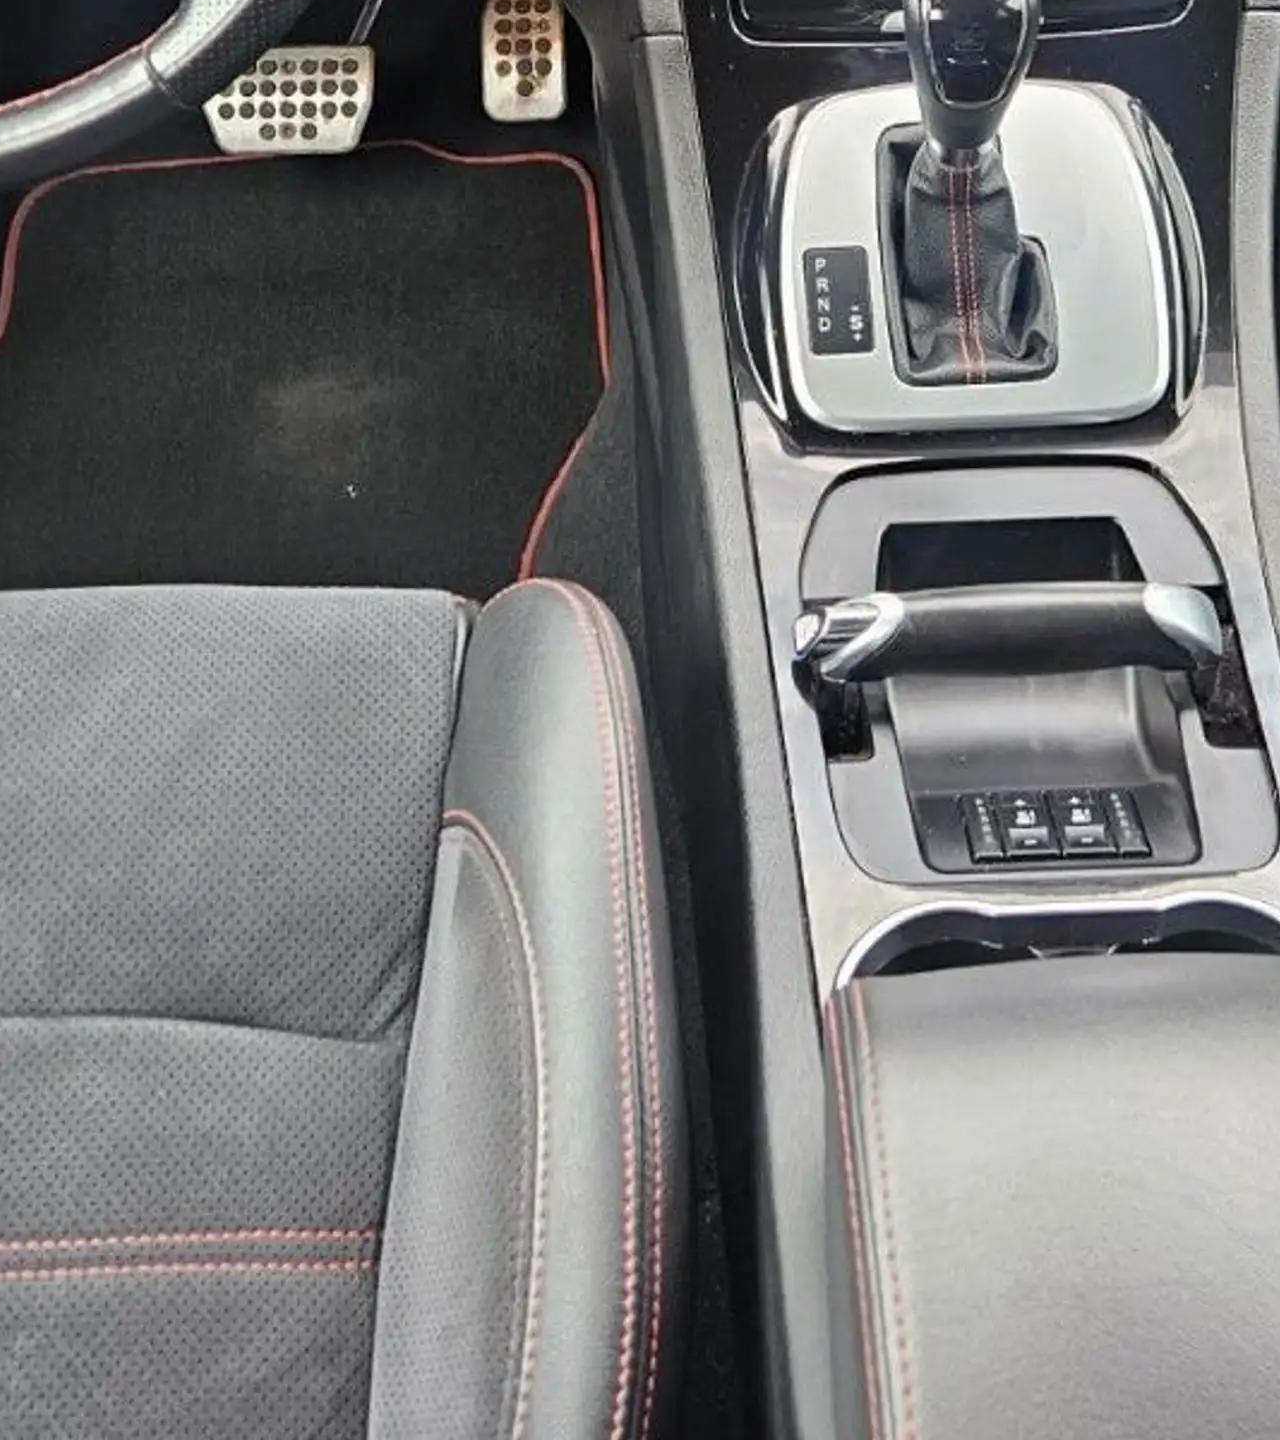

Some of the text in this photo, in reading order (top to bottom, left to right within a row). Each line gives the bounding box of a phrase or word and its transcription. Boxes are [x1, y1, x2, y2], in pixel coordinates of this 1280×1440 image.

[815, 257, 826, 272] P
[816, 277, 829, 292] R
[817, 297, 830, 312] N
[818, 317, 831, 332] D
[848, 314, 864, 330] S
